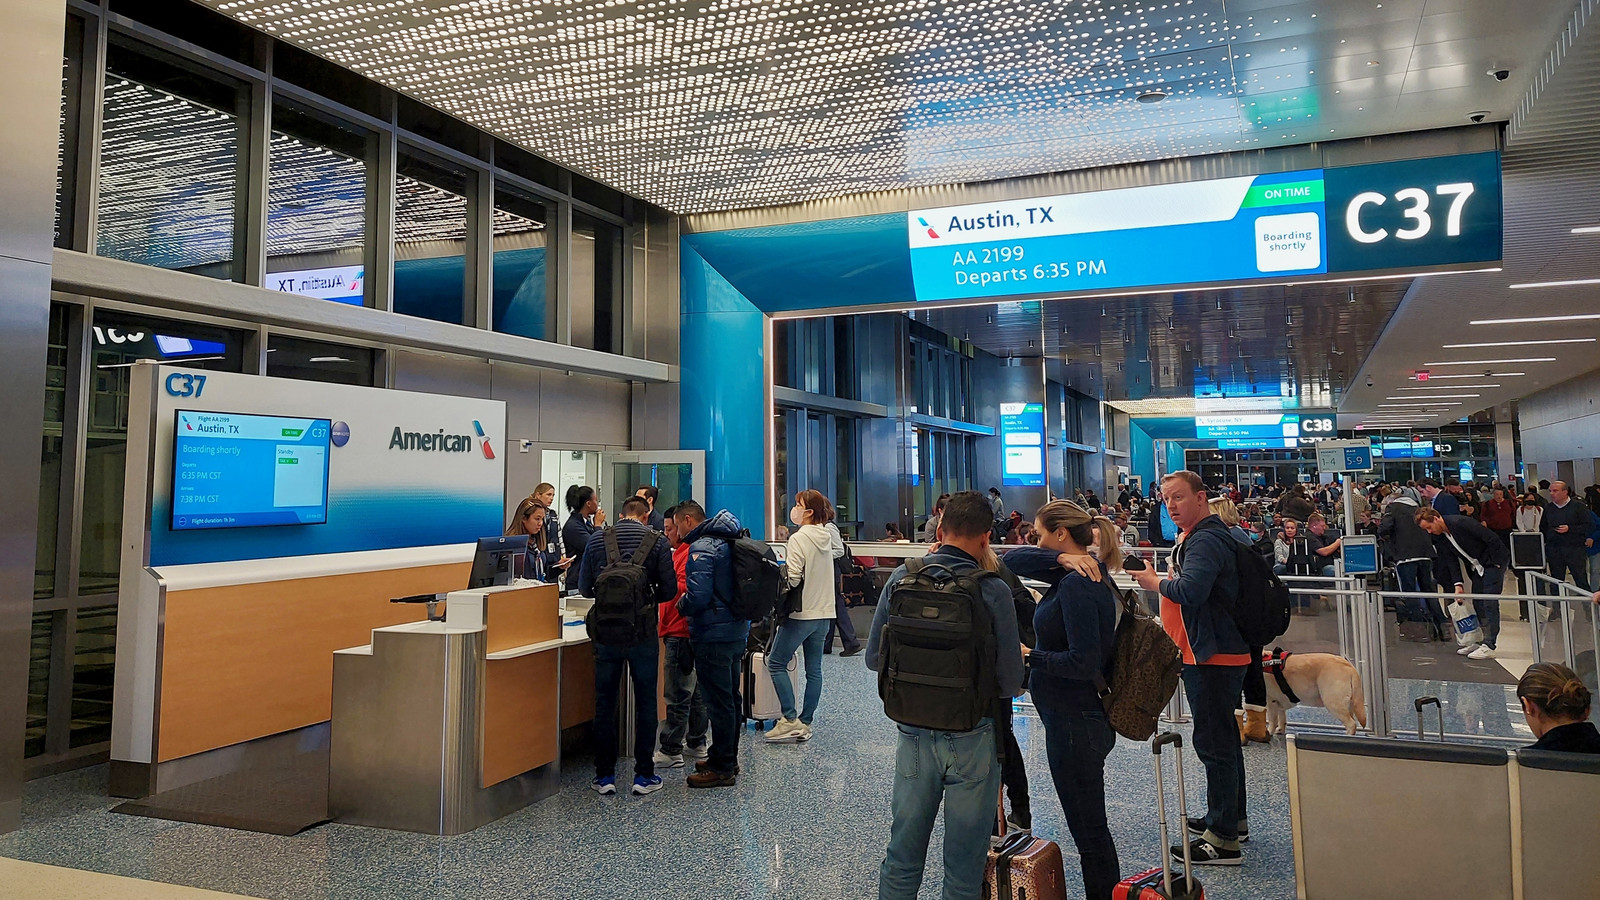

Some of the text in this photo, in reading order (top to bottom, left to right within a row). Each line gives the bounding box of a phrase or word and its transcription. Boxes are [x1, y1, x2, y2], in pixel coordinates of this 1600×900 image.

[1264, 187, 1311, 199] ON TIME
[1346, 182, 1475, 243] C37
[948, 206, 1054, 232] Austin, TX
[1263, 231, 1312, 241] Boarding
[1269, 241, 1306, 251] shortly
[952, 245, 1025, 266] AA 2199
[955, 259, 1107, 287] Departs 6:35 PM
[165, 372, 207, 398] C37
[197, 423, 240, 434] Austin, TX
[1302, 418, 1333, 432] C38
[311, 428, 327, 438] C37
[388, 426, 472, 453] American
[182, 444, 241, 457] Boarding shortly
[1321, 457, 1336, 466] 1-4
[1346, 456, 1363, 465] 5-9
[197, 471, 208, 480] PM
[209, 471, 222, 480] CST
[194, 495, 206, 503] PM
[207, 494, 220, 503] CST
